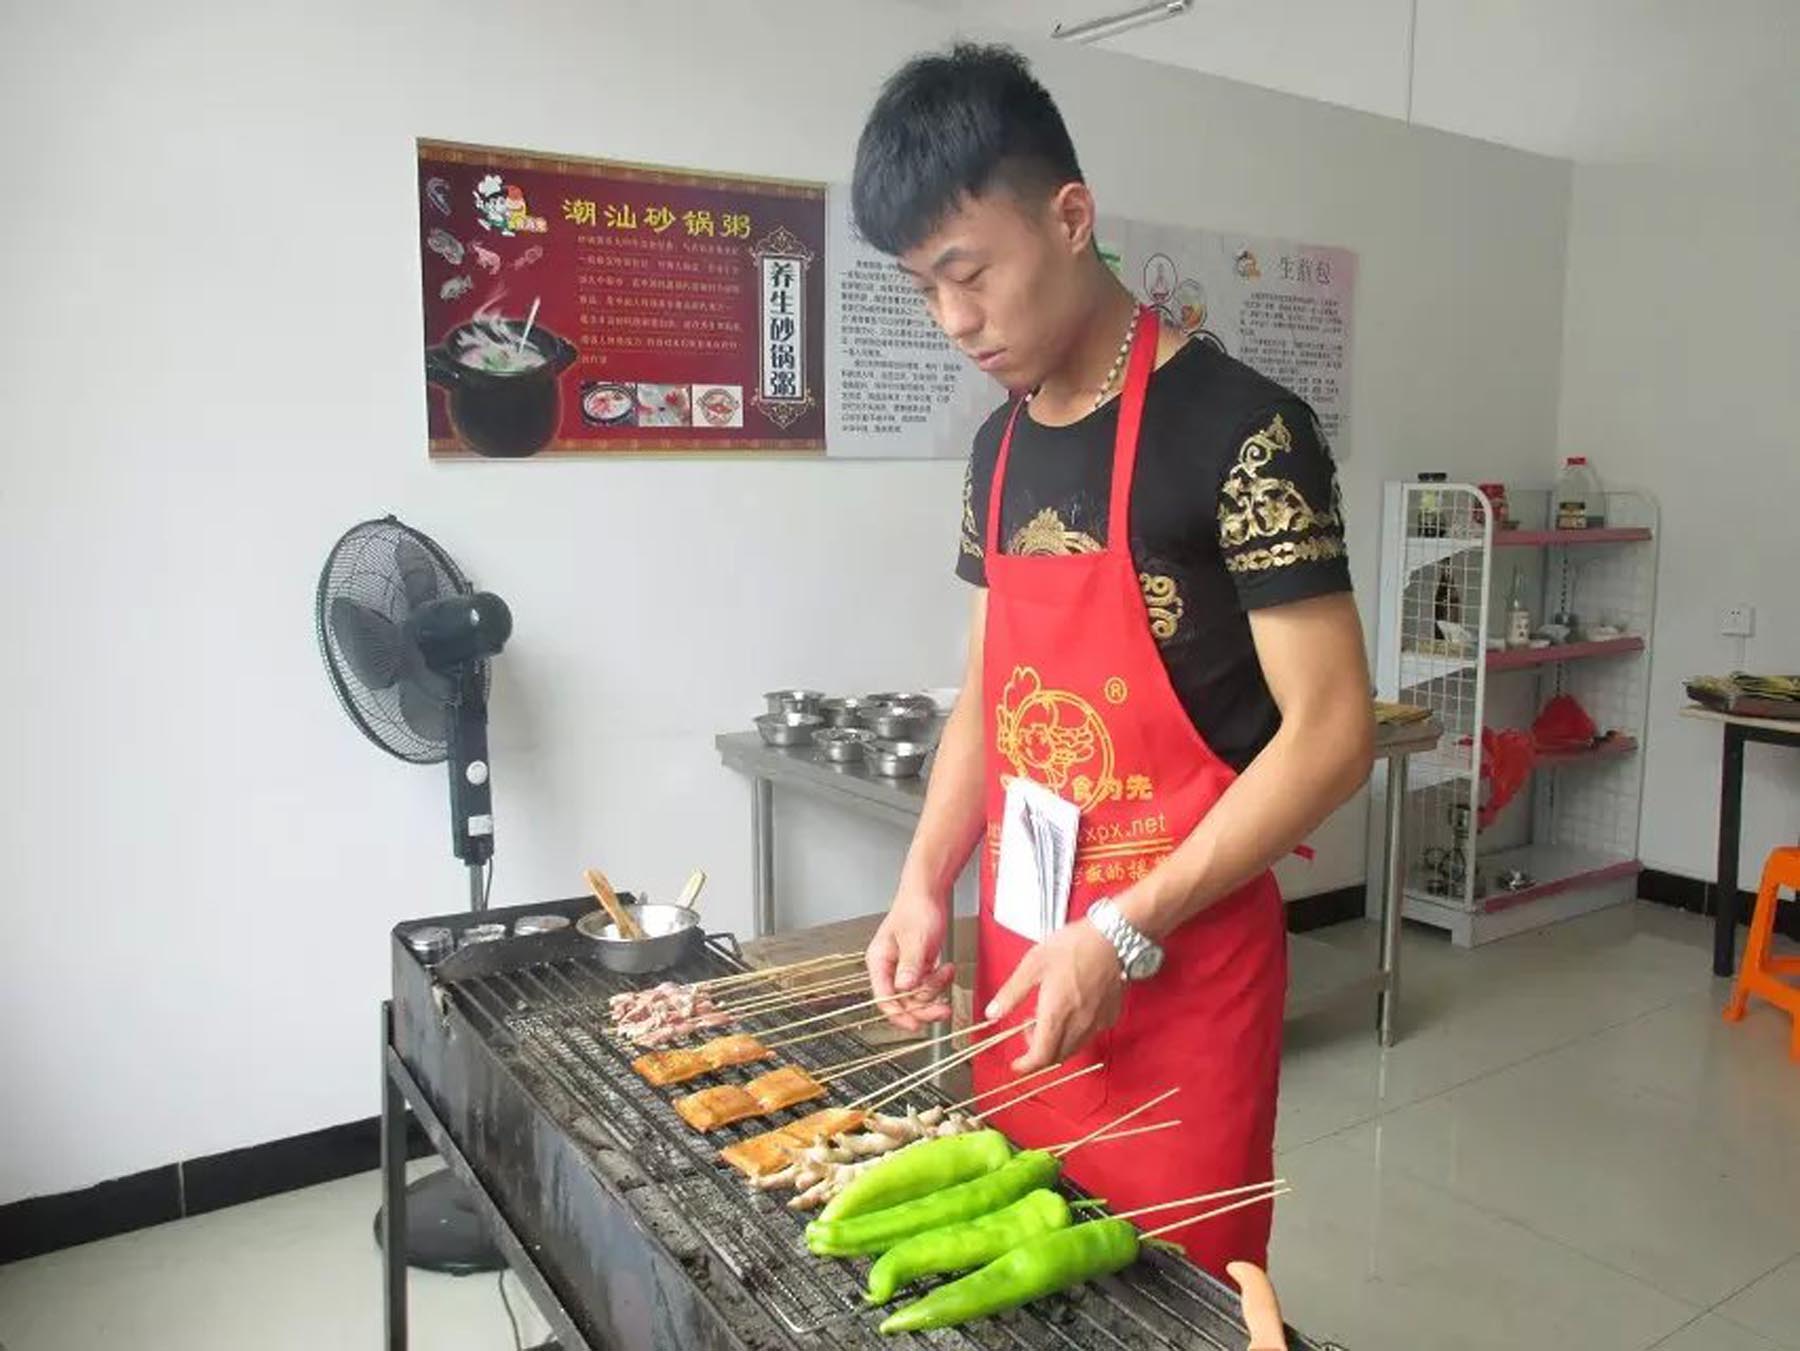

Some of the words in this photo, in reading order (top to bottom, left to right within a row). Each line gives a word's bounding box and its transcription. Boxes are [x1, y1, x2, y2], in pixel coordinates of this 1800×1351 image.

[562, 198, 751, 240] 潮汕砂锅粥
[769, 261, 796, 396] 养生砂锅粥
